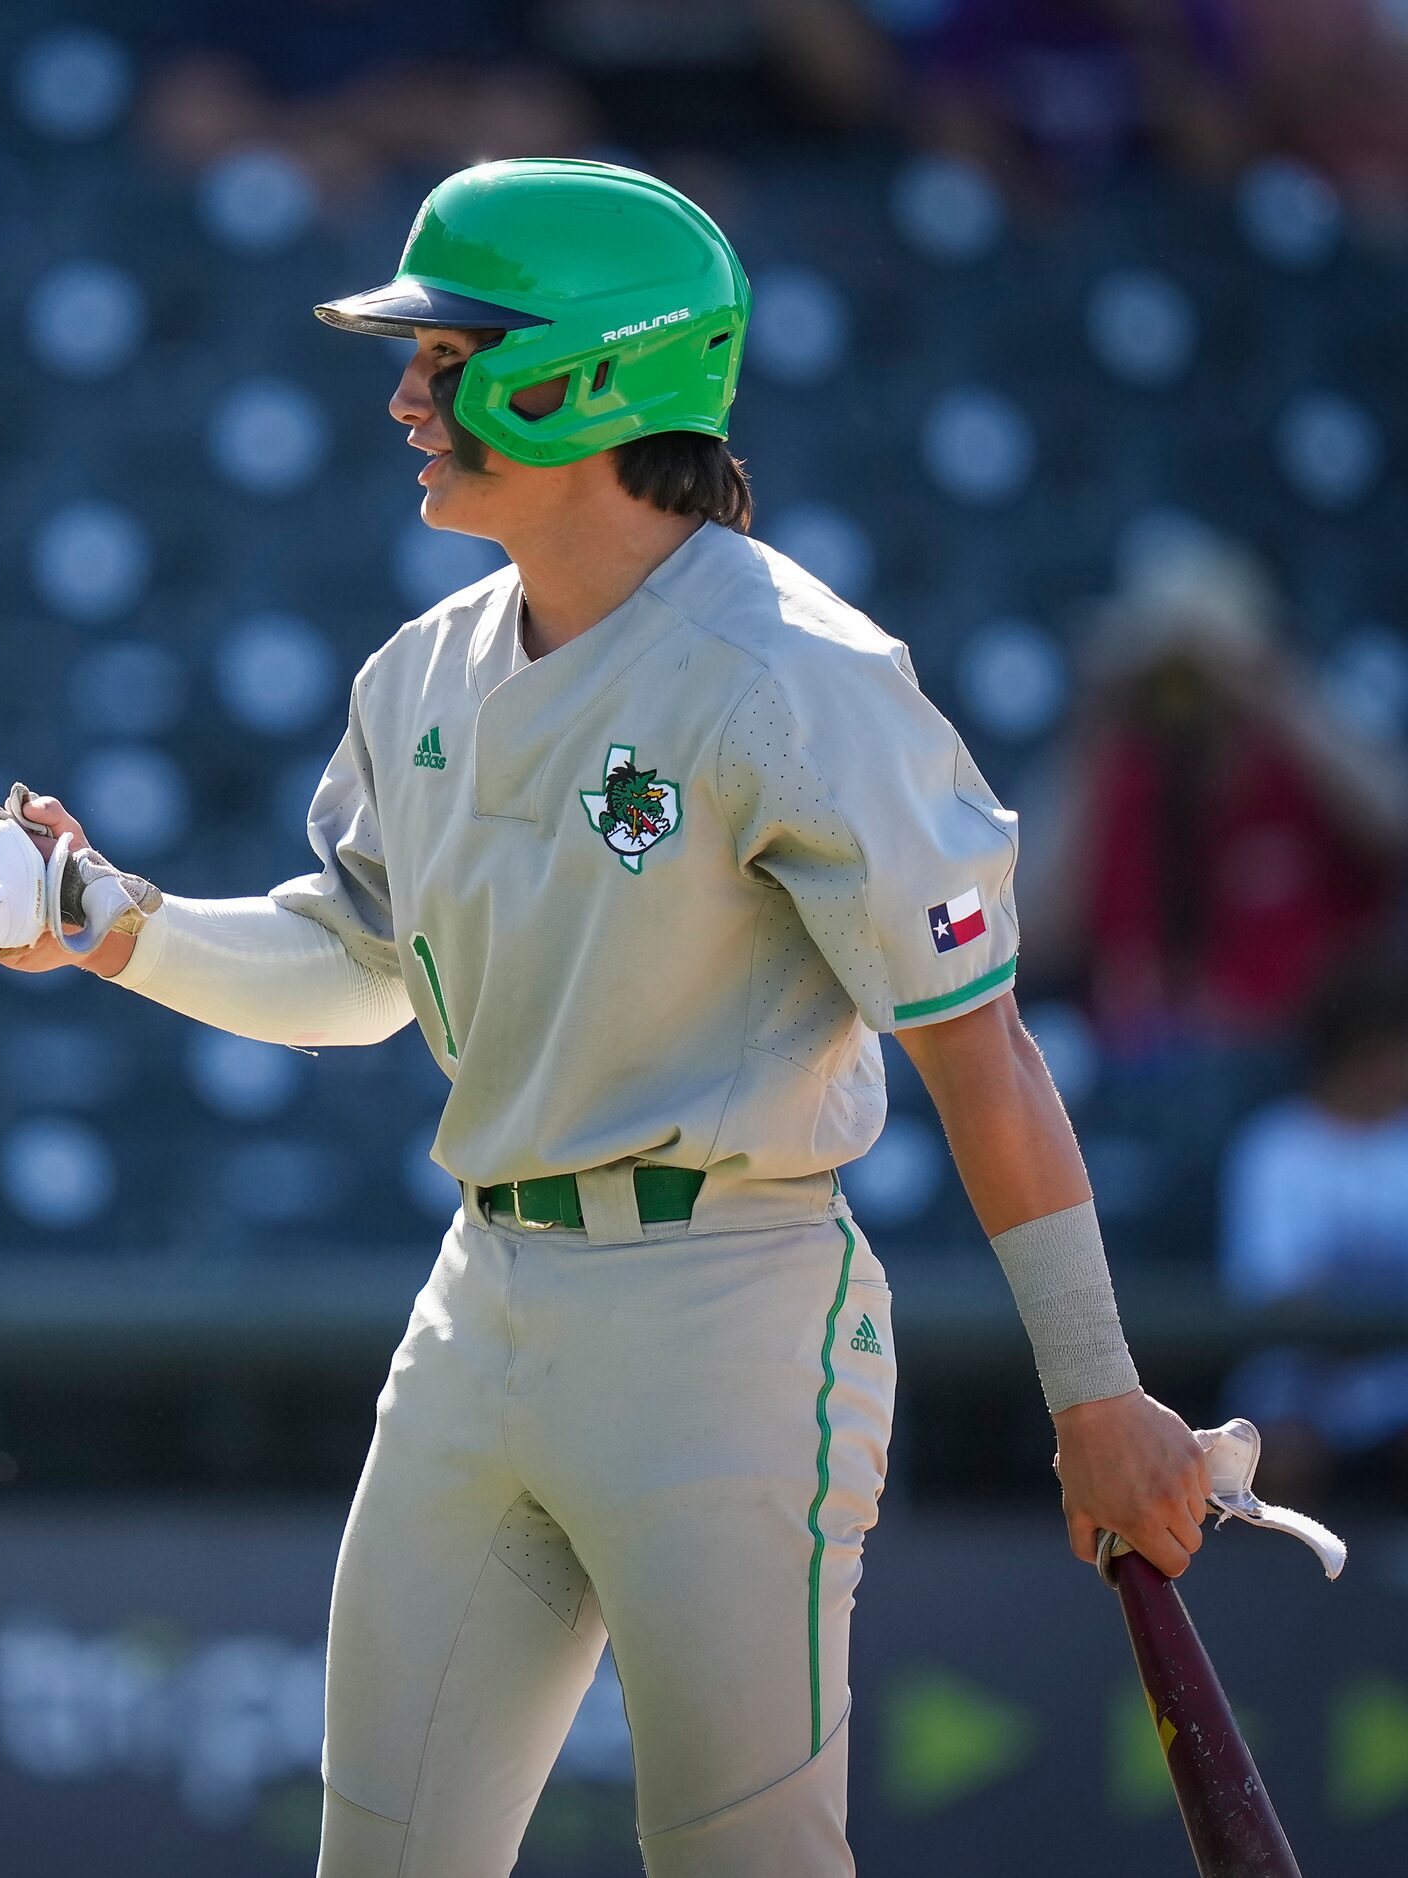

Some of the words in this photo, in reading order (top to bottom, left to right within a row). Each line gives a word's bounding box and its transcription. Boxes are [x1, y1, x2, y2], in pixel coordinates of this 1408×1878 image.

[601, 307, 691, 343] RAWLINGS
[413, 752, 447, 770] adidas
[408, 930, 459, 1066] 1
[850, 1337, 882, 1356] adidas
